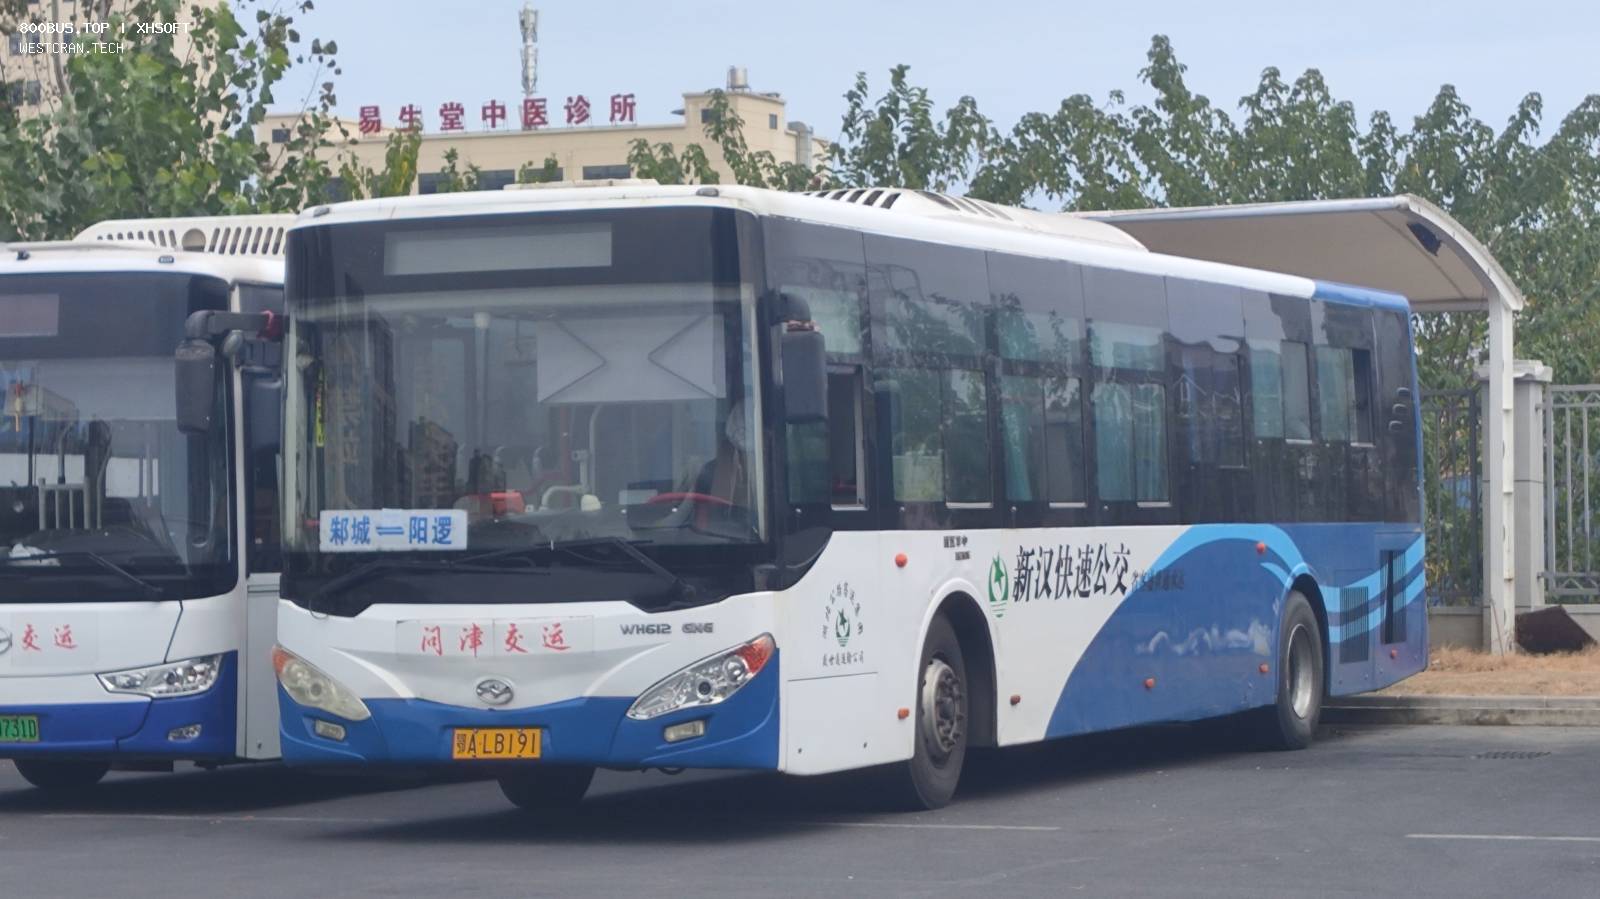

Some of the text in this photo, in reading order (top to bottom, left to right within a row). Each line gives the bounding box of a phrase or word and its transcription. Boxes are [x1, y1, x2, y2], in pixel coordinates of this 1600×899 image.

[359, 94, 636, 134] 易生堂中医诊所
[1012, 543, 1131, 602] 新汉快速公交
[22, 624, 78, 650] 交运
[421, 622, 571, 657] 问津交运
[620, 623, 672, 635] WH612
[0, 719, 37, 738] 731D
